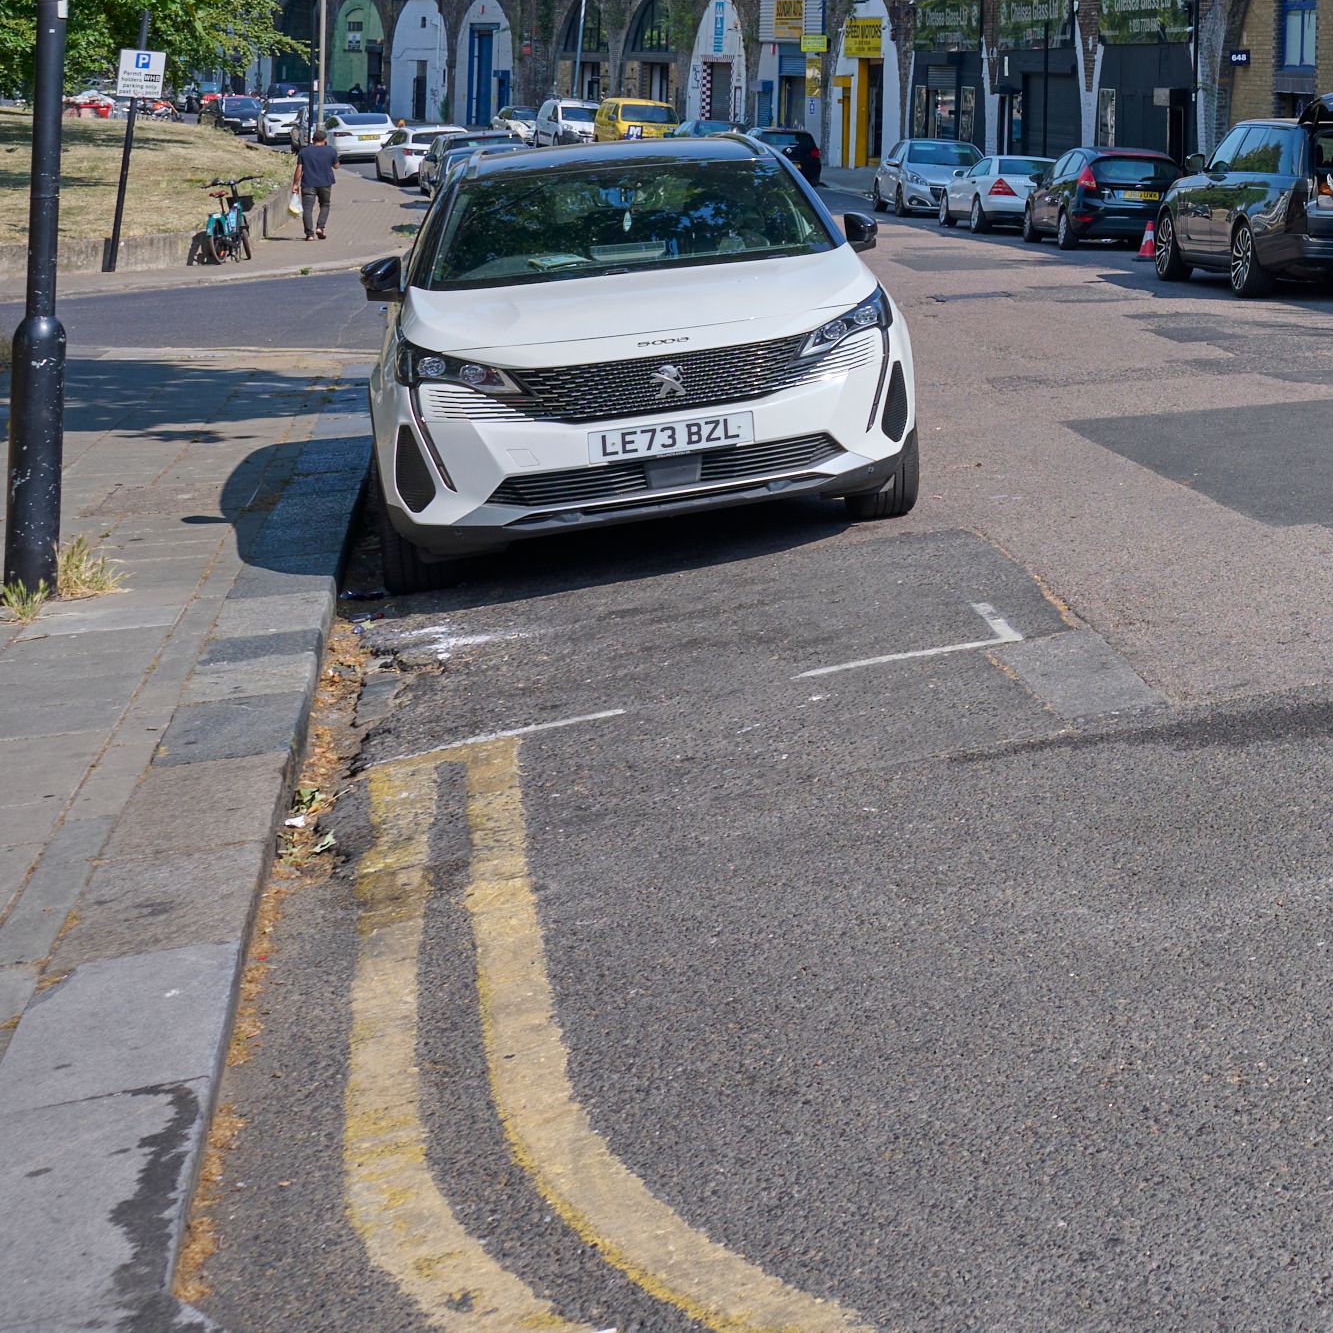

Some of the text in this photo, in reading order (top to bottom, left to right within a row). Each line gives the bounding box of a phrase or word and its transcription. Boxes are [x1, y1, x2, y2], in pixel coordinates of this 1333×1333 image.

[138, 54, 150, 68] P
[1230, 54, 1247, 62] 648
[637, 336, 690, 348] 5008
[601, 418, 740, 457] LE73 BZL
